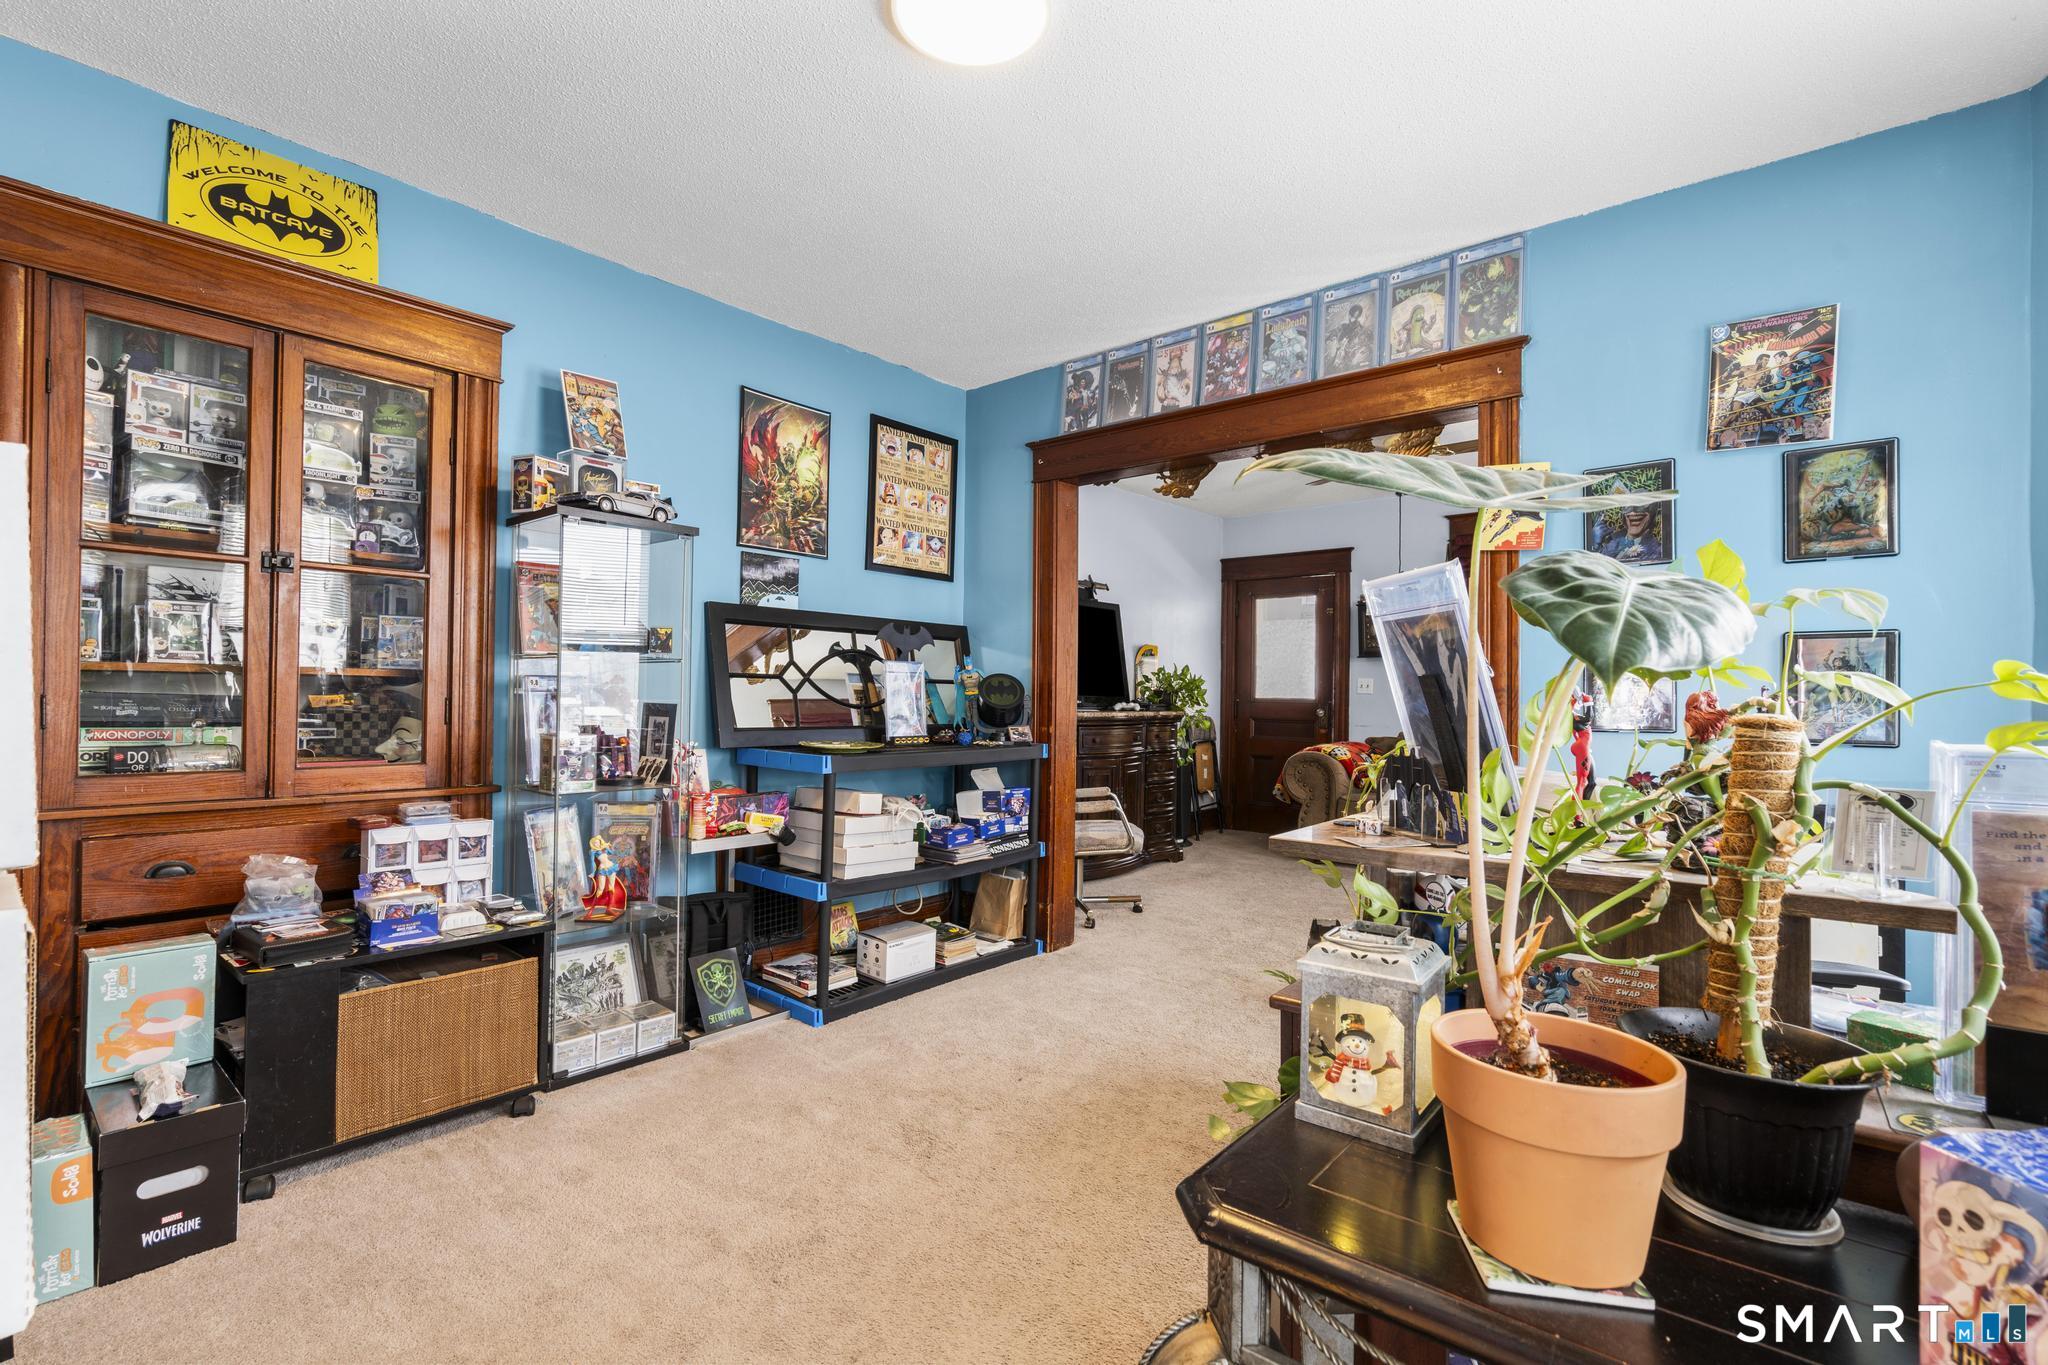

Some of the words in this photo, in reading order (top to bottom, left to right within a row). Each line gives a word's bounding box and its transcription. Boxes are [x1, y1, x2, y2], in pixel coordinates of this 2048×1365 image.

[182, 165, 288, 184] WELCOME
[300, 183, 324, 201] TO
[335, 204, 367, 237] THE
[219, 195, 334, 239] BATCAVE
[1743, 315, 1808, 331] STAR-WARRIORS
[880, 424, 904, 438] WANTED
[905, 431, 927, 444] WANTED
[929, 438, 951, 451] WANTED
[163, 444, 179, 452] ZERO
[189, 448, 222, 460] DOGHOUSE
[878, 472, 902, 484] WANTED
[903, 478, 925, 490] WANTED
[927, 484, 949, 496] WANTED
[876, 517, 900, 528] WANTED
[902, 522, 925, 533] WANTED
[925, 527, 947, 538] WANTED
[94, 730, 171, 739] MONOPOLY
[127, 751, 149, 764] DO
[1985, 831, 2018, 839] Find
[2023, 831, 2047, 839] the
[2014, 843, 2041, 851] and
[832, 905, 847, 920] MARS
[831, 915, 853, 933] ATTACKS
[103, 968, 119, 1001] POTTERY
[1602, 976, 1629, 986] COMIC
[1630, 981, 1658, 990] BOOK
[1616, 988, 1641, 997] SWAP
[1584, 995, 1616, 1005] SATURDAY
[708, 1010, 728, 1025] SECRET
[728, 1006, 745, 1020] EMPIRE
[161, 1212, 183, 1224] MARVEL
[141, 1217, 201, 1247] WOLVERINE
[41, 1254, 59, 1294] POTTERY
